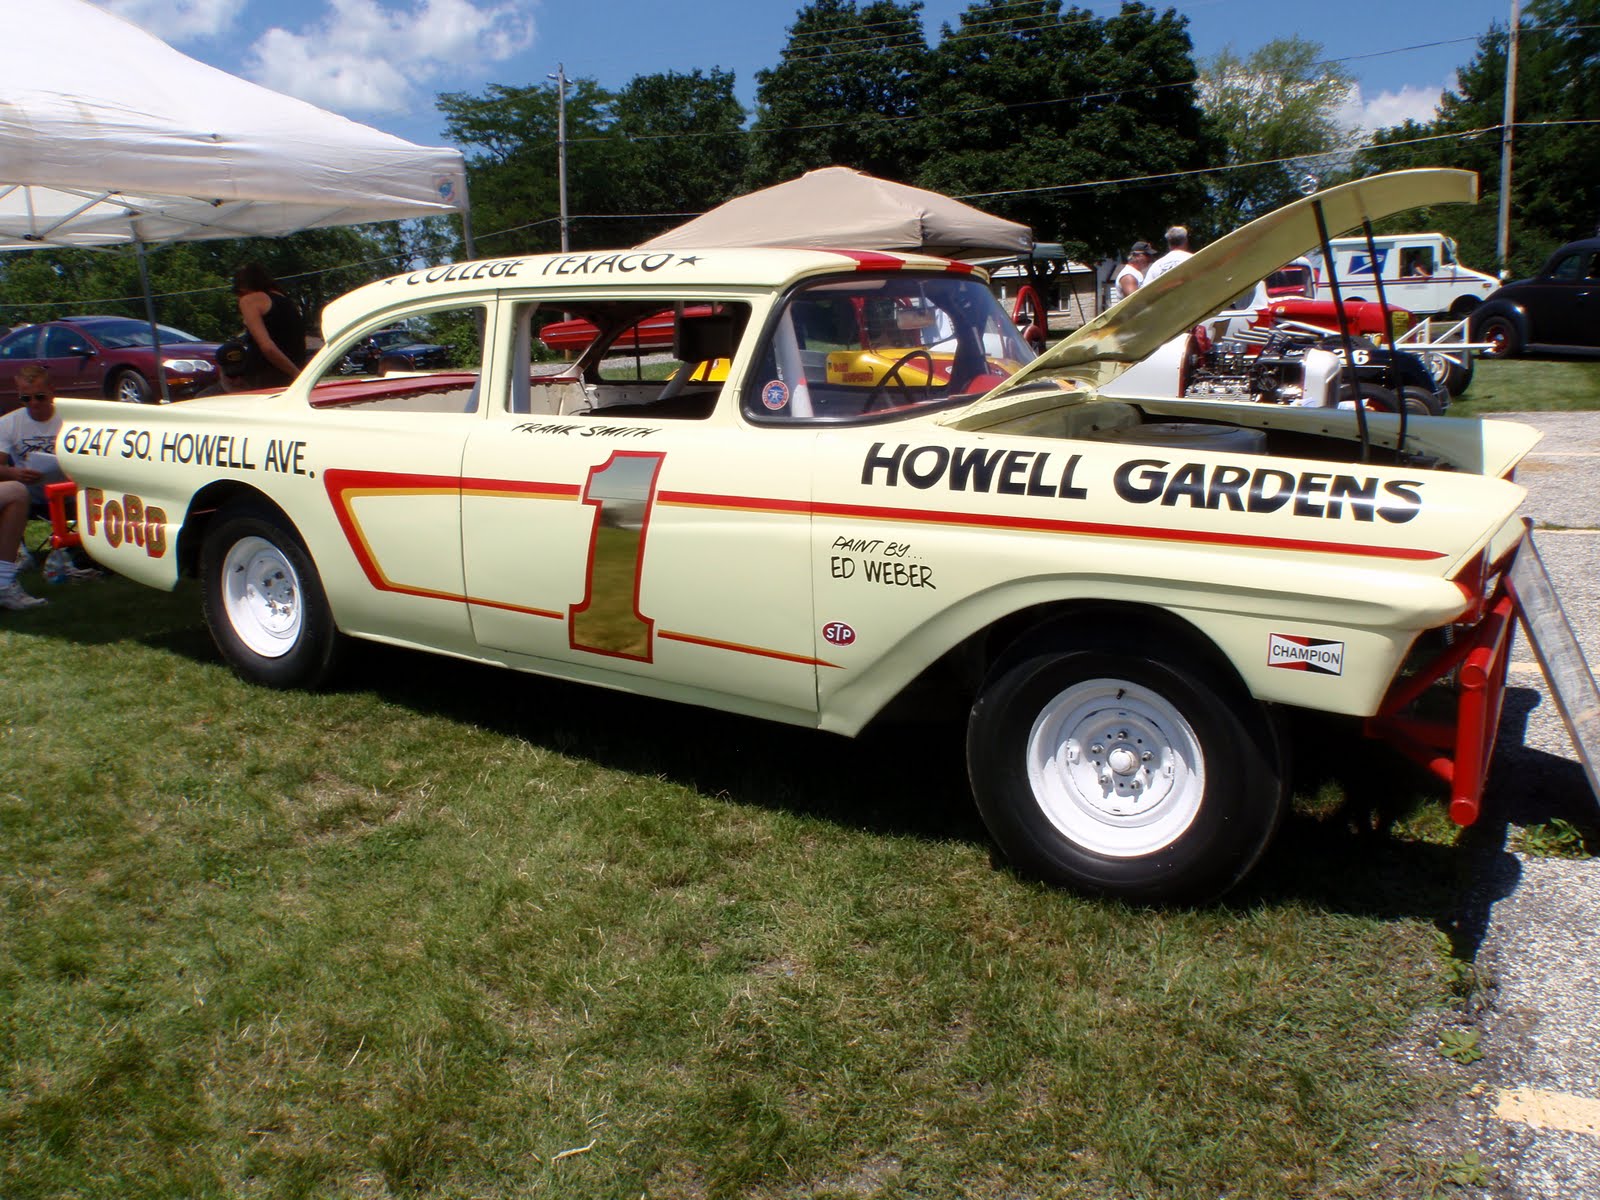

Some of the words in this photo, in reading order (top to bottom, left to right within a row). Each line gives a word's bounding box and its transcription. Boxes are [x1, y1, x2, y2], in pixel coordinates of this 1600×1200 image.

[406, 257, 533, 287] COLLEGE
[541, 252, 675, 276] TEXACO
[511, 422, 584, 436] FRANK
[579, 424, 664, 438] SMITH
[63, 426, 118, 457] 6247
[121, 429, 153, 462] SO.
[160, 432, 256, 470] HOWELL
[264, 439, 316, 479] AVE.
[860, 441, 1089, 500] HOWELL
[1112, 458, 1426, 524] GARDENS
[84, 487, 169, 559] FORD
[567, 448, 668, 664] 1
[831, 535, 885, 554] PAINT
[830, 556, 856, 579] ED
[863, 559, 937, 590] WEBER
[825, 623, 853, 642] STP
[1272, 644, 1341, 665] CHAMPION
